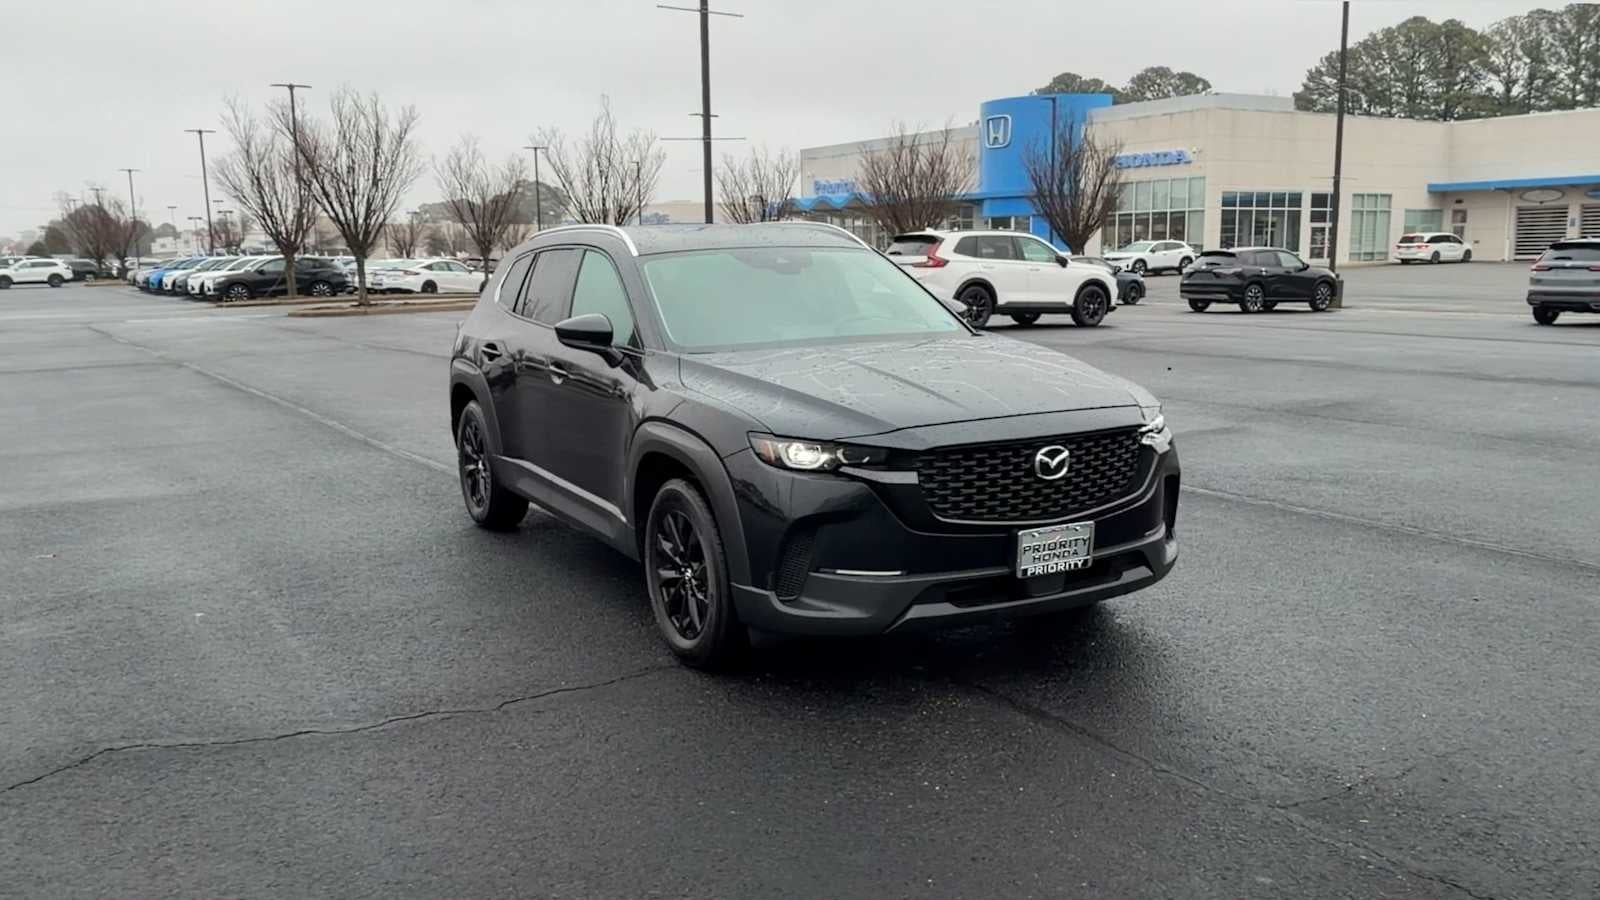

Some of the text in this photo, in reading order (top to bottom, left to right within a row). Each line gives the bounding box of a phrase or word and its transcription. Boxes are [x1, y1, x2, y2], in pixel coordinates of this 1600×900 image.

[1023, 536, 1089, 554] PRIORITY
[1032, 548, 1079, 562] HONDA
[1027, 559, 1083, 576] PRIORITY
